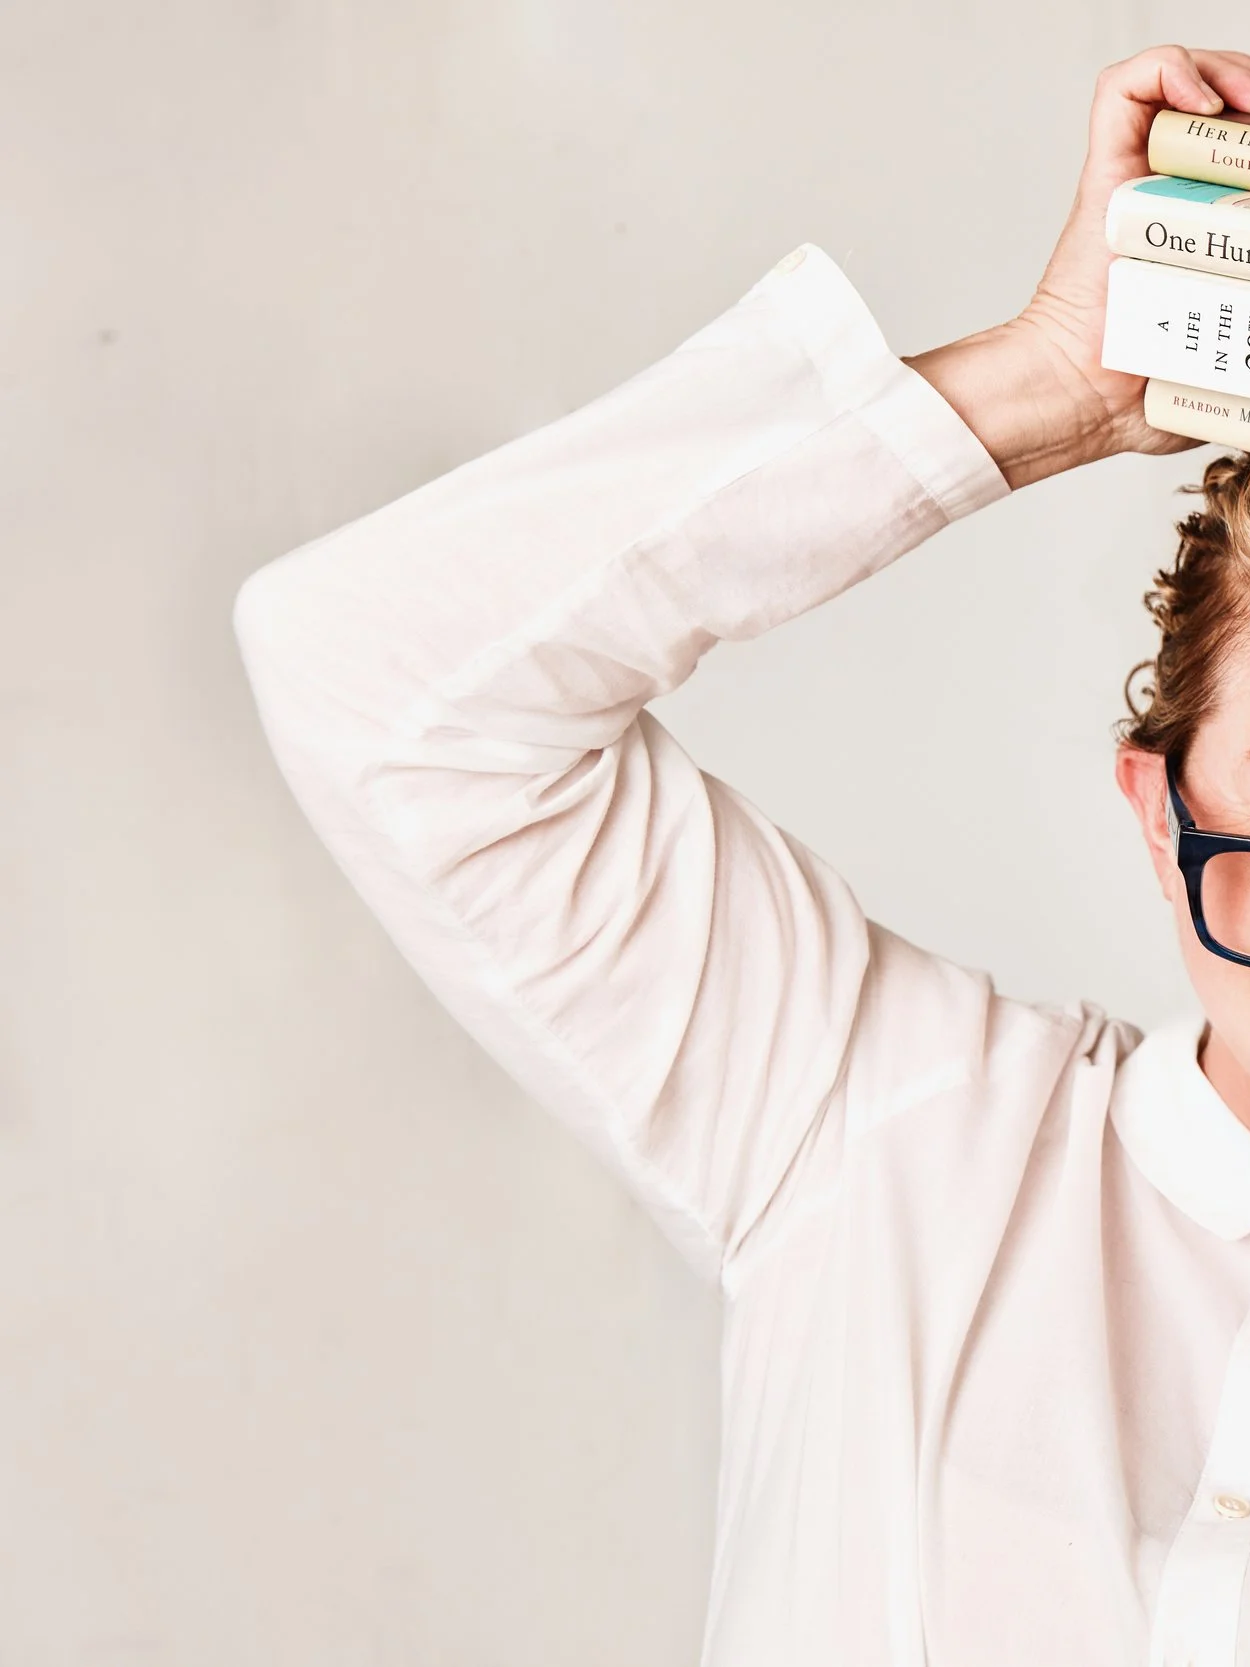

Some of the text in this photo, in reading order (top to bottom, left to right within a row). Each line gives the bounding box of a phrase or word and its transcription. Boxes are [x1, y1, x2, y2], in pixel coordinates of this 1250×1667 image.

[1186, 120, 1228, 143] HER
[1145, 221, 1196, 254] One
[1157, 320, 1169, 332] A
[1185, 310, 1201, 352] LIFE
[1214, 303, 1233, 372] IN THE
[1172, 396, 1231, 419] REARDON
